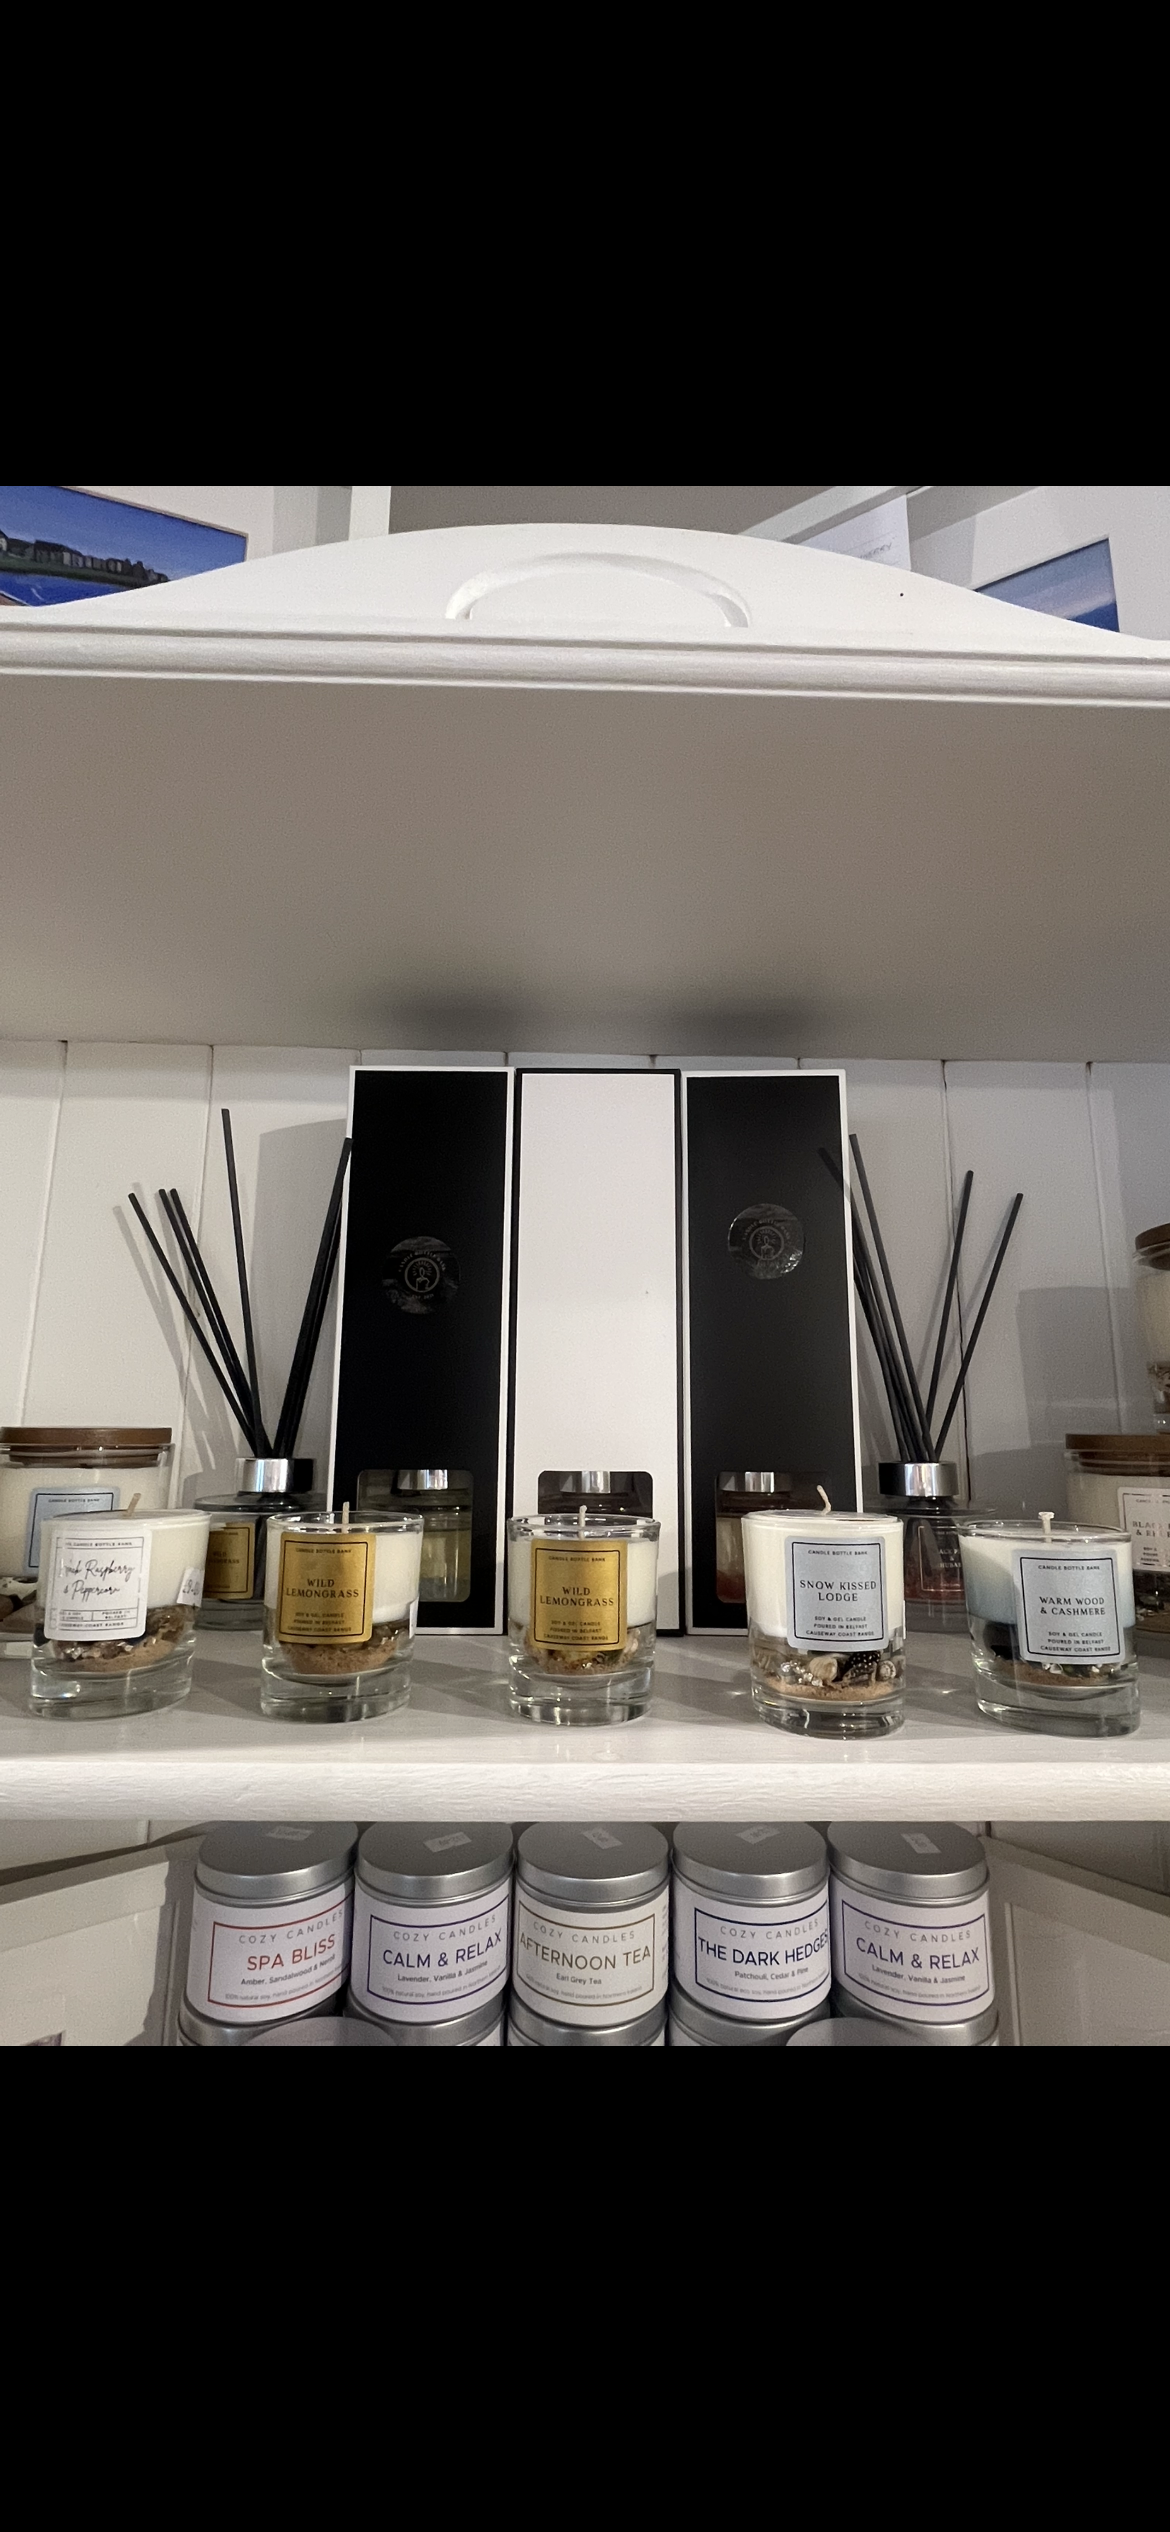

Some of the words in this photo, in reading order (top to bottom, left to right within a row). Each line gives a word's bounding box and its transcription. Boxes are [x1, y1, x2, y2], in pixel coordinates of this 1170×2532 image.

[84, 1558, 136, 1583] Raspberry
[71, 1579, 121, 1603] Peppercorn
[306, 1578, 335, 1588] WILD
[562, 1586, 591, 1596] WILD
[799, 1579, 835, 1590] SNOW
[839, 1580, 877, 1591] KISSED
[285, 1588, 360, 1599] LEMONGRASS
[539, 1595, 614, 1607] LEMONGRASS
[817, 1592, 859, 1602] LODGE
[1039, 1596, 1072, 1606] WARM
[1075, 1596, 1105, 1606] WOOD
[1039, 1606, 1048, 1615] &
[1051, 1607, 1106, 1616] CASHMERE
[805, 1629, 837, 1637] CAUSEWAY
[238, 1933, 278, 1945] COZY
[286, 1908, 344, 1940] CANDLES
[393, 1930, 431, 1942] COZY
[438, 1914, 497, 1941] CANDLES
[533, 1920, 563, 1939] COZY
[571, 1930, 636, 1944] CANDLES
[719, 1925, 757, 1940] COZY
[765, 1918, 819, 1940] CANDLES
[864, 1920, 900, 1940] COZY
[909, 1929, 971, 1943] CANDLES
[246, 1953, 285, 1971] SPA
[291, 1933, 337, 1965] BLISS
[382, 1949, 431, 1969] CALM
[437, 1952, 449, 1967] &
[455, 1927, 503, 1964] RELAX
[519, 1932, 617, 1971] AFTERNOON
[622, 1945, 651, 1967] TEA
[698, 1935, 728, 1962] THE
[732, 1948, 780, 1967] DARK
[784, 1927, 829, 1965] HEDGES
[855, 1936, 904, 1966] CALM
[910, 1953, 923, 1969] &
[929, 1946, 980, 1970] RELAX
[269, 1966, 313, 1984] Sandalwood
[433, 1972, 457, 1982] Vanilla
[464, 1960, 488, 1976] Jasmine
[556, 1972, 570, 1983] Earl
[570, 1974, 587, 1986] Grey
[589, 1977, 602, 1985] Tea
[734, 1970, 769, 1981] Patchouli,
[770, 1971, 790, 1981] Cedar
[796, 1966, 809, 1975] Pine
[907, 1974, 932, 1984] Vanilla
[933, 1976, 939, 1984] &
[939, 1974, 966, 1984] Jasmine
